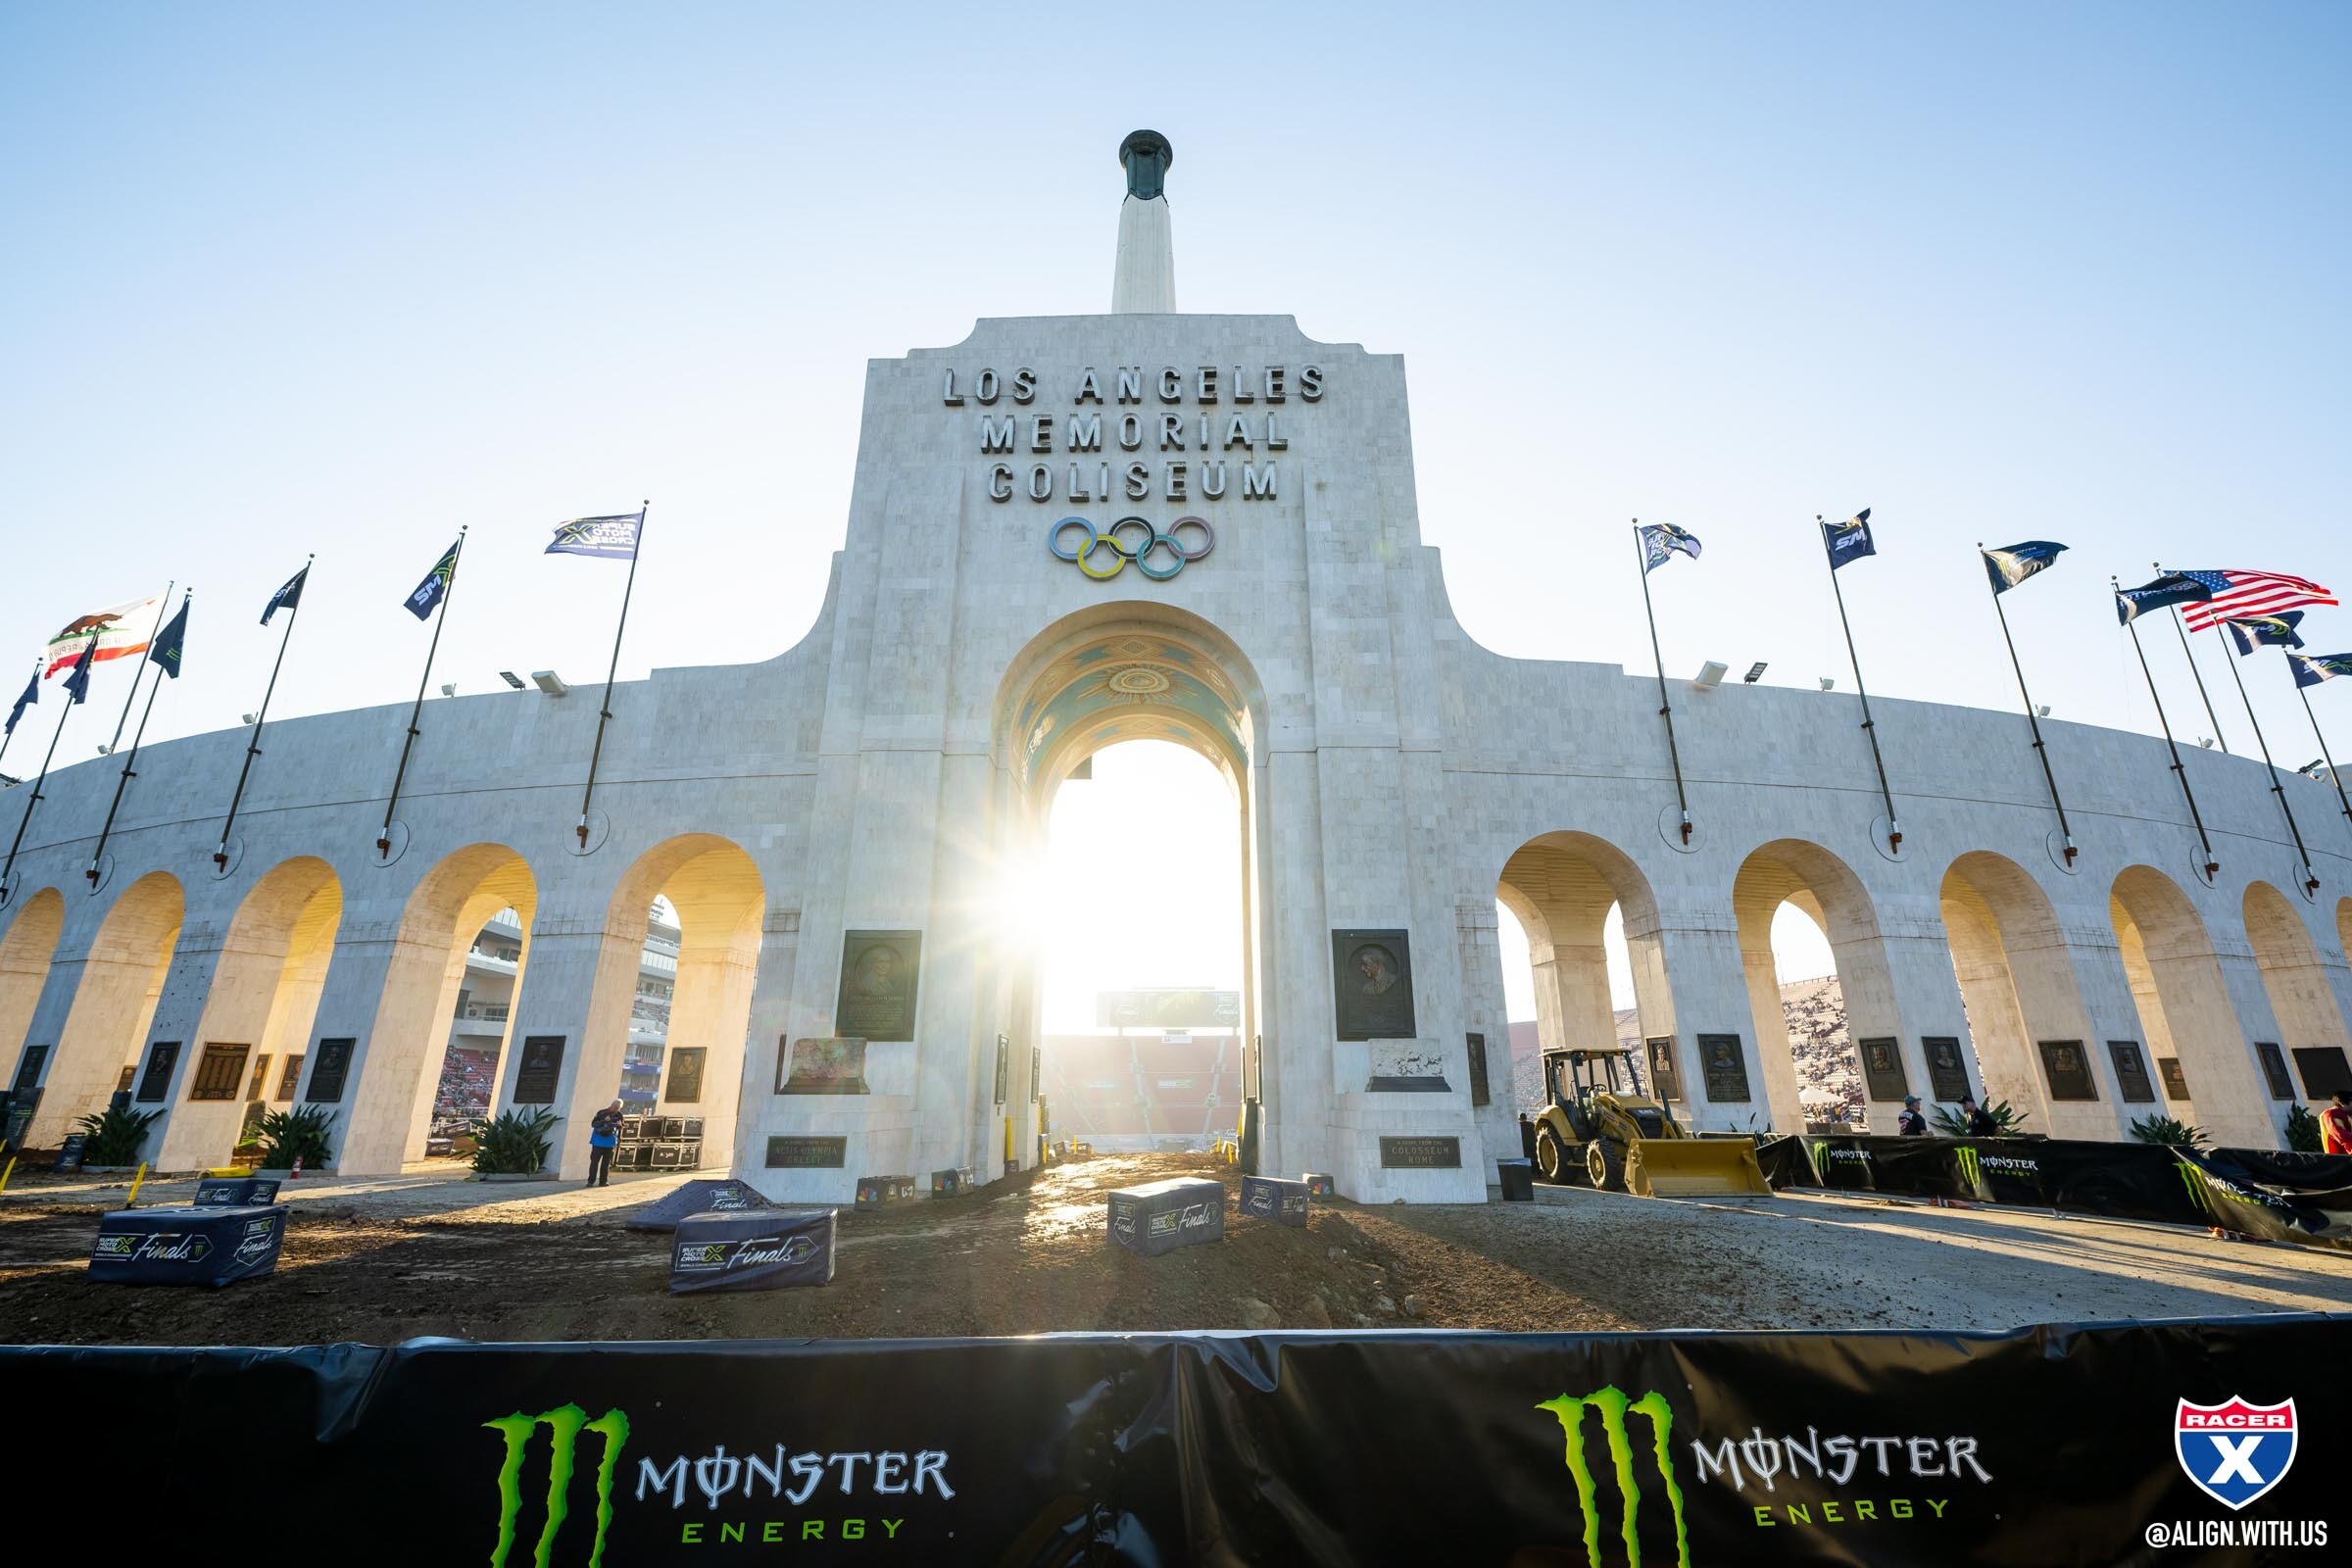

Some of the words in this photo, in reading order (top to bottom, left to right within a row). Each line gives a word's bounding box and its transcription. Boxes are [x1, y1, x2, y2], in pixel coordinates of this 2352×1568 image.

[944, 367, 1037, 407] LOS
[1074, 365, 1324, 405] ANGELES
[980, 412, 1289, 454] MEMORIAL
[987, 461, 1277, 503] COLISEUM
[1830, 1149, 1872, 1160] MONSTER
[1980, 1155, 2039, 1171] MONSTER
[2222, 1192, 2271, 1206] ENERG
[1177, 1202, 1210, 1232] Finals
[131, 1232, 193, 1261] Finals
[232, 1233, 272, 1258] Finals
[726, 1236, 794, 1269] Finals
[1690, 1425, 1993, 1493] MONSTER
[635, 1443, 956, 1510] MONSTER
[1753, 1498, 1949, 1528] ENERGY
[682, 1518, 905, 1544] ENERGY
